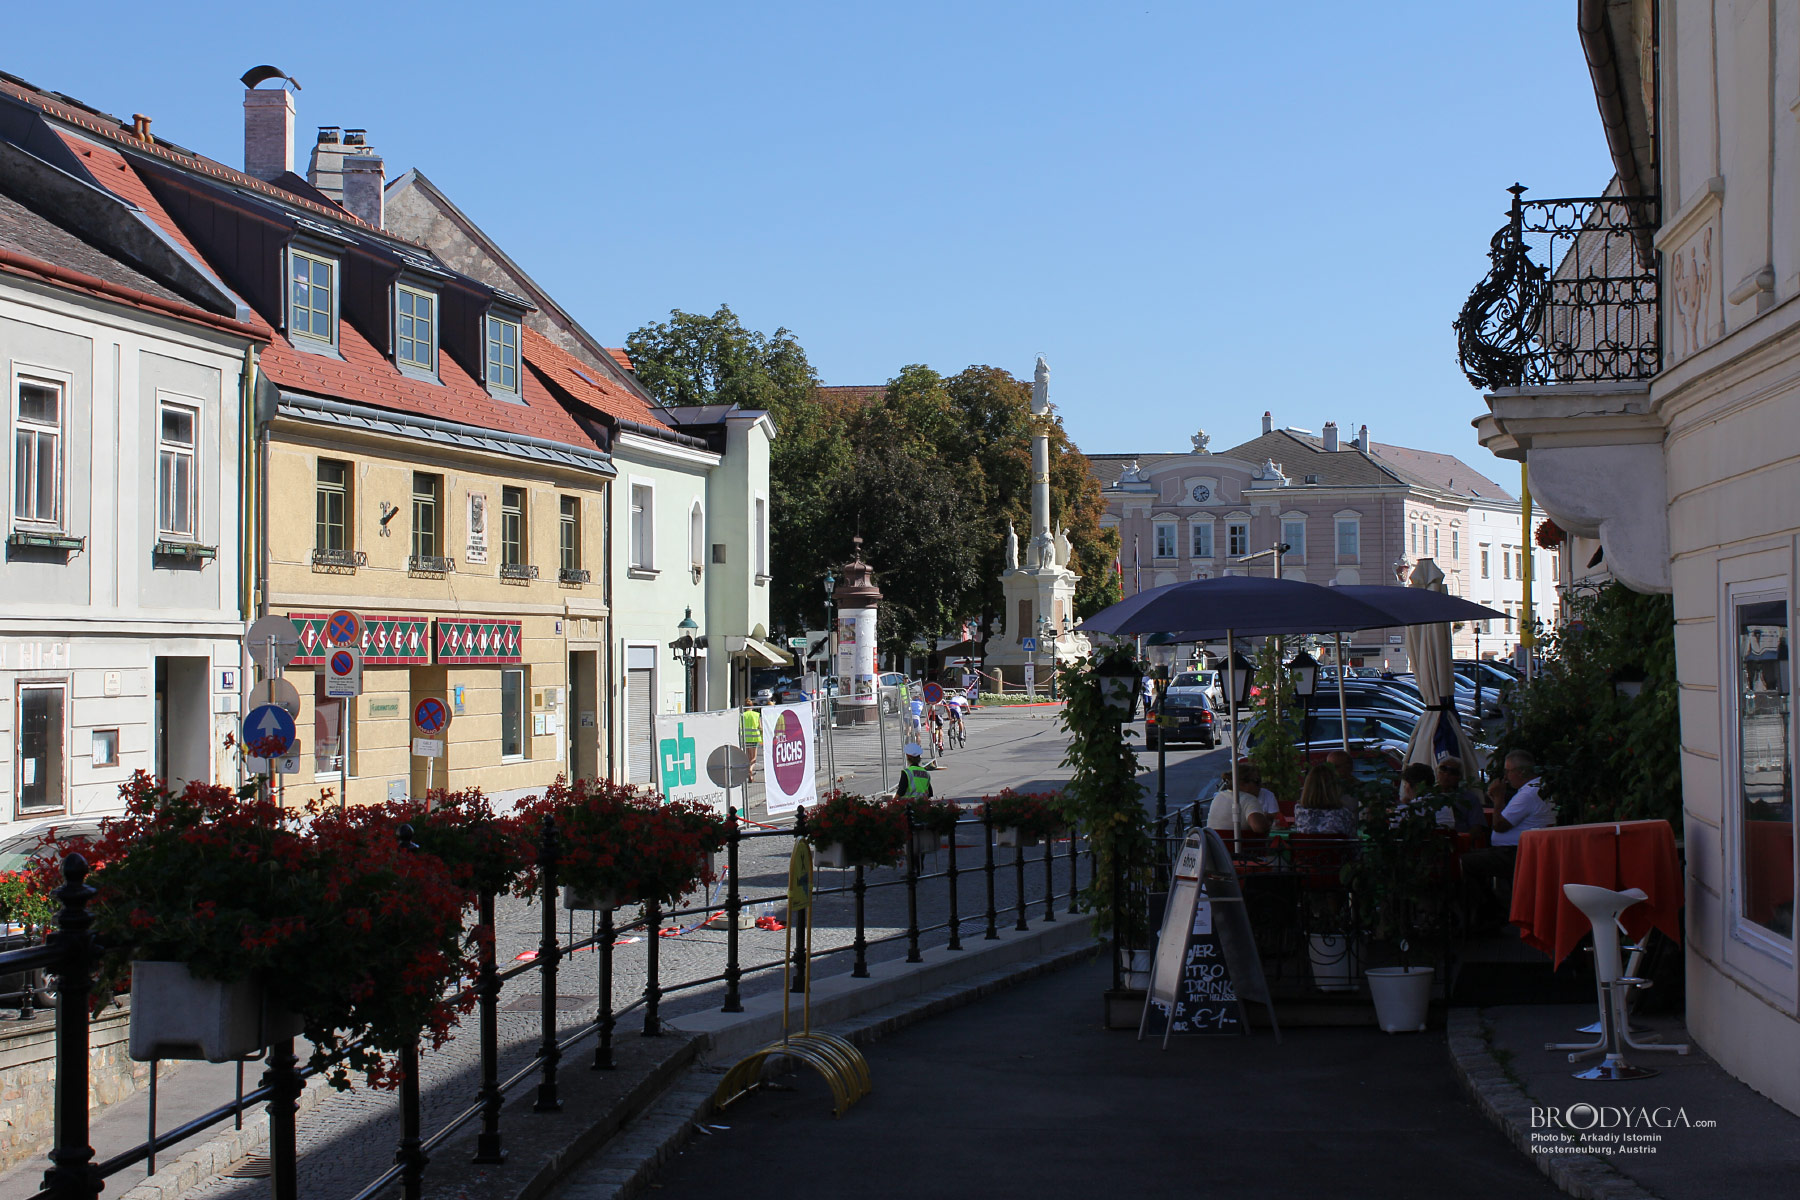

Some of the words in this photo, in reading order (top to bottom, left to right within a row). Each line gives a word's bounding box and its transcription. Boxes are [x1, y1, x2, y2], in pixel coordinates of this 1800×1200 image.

[307, 630, 419, 649] FLESEN
[451, 631, 514, 649] ZANKL
[225, 672, 233, 684] 10
[775, 740, 803, 764] FUCHS
[1183, 853, 1196, 871] shop
[1189, 993, 1208, 1002] MIT
